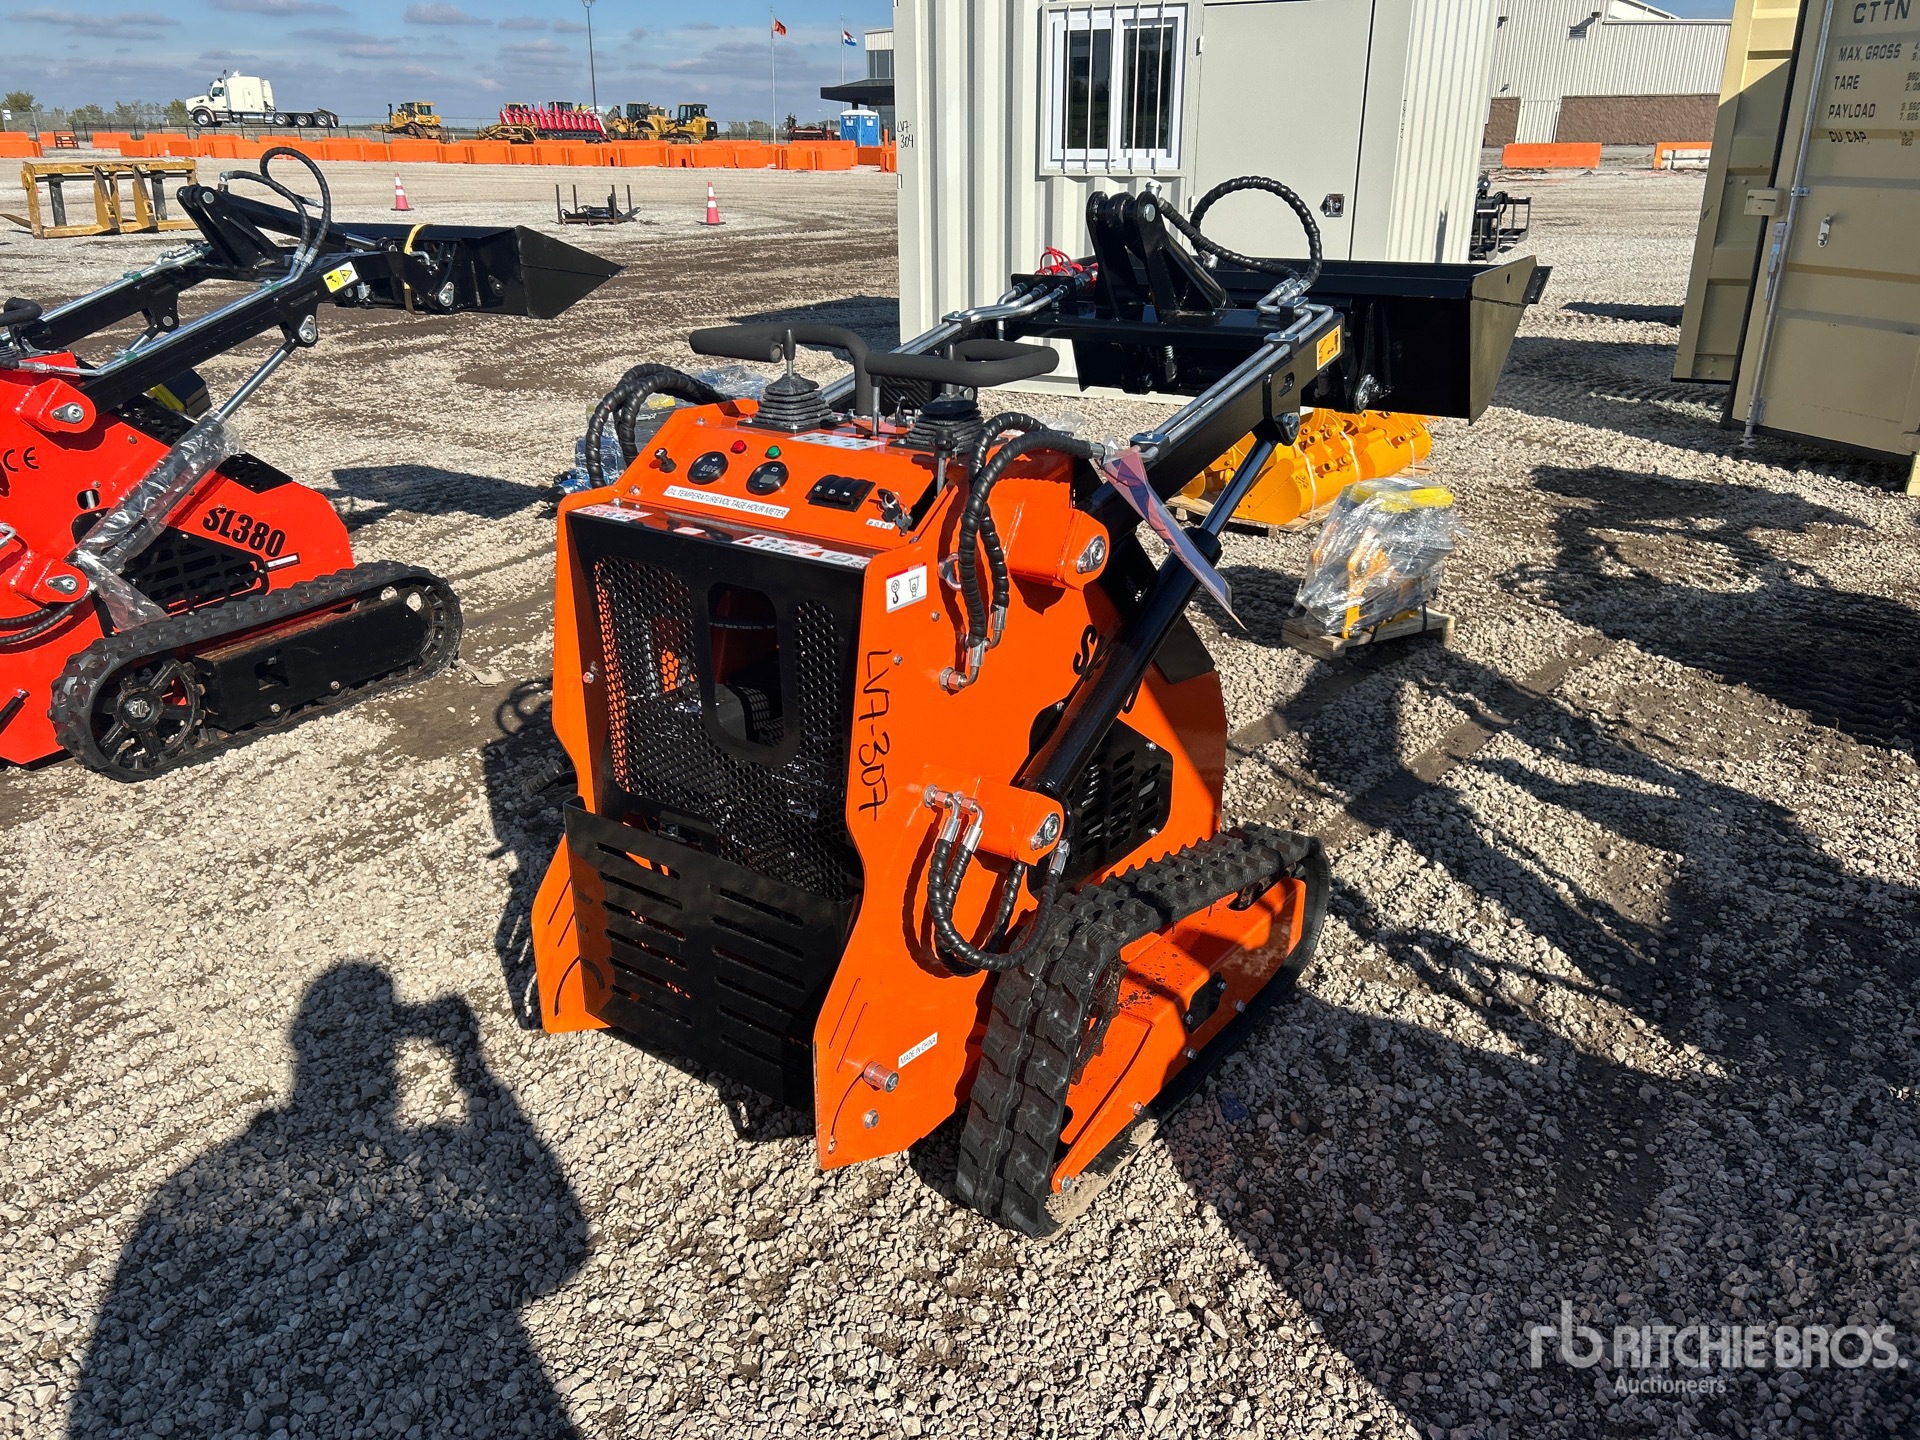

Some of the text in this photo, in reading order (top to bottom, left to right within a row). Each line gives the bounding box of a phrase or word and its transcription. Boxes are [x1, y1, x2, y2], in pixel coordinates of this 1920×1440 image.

[1853, 0, 1911, 24] CTTN
[1834, 75, 1860, 90] TARE
[1828, 103, 1876, 119] PAYLOAD
[900, 134, 914, 149] 304
[3, 446, 40, 473] CE
[747, 503, 763, 513] HOUR
[765, 506, 786, 517] METER
[202, 507, 286, 558] SL380
[901, 1049, 915, 1064] MADE
[921, 1037, 936, 1051] CHINA
